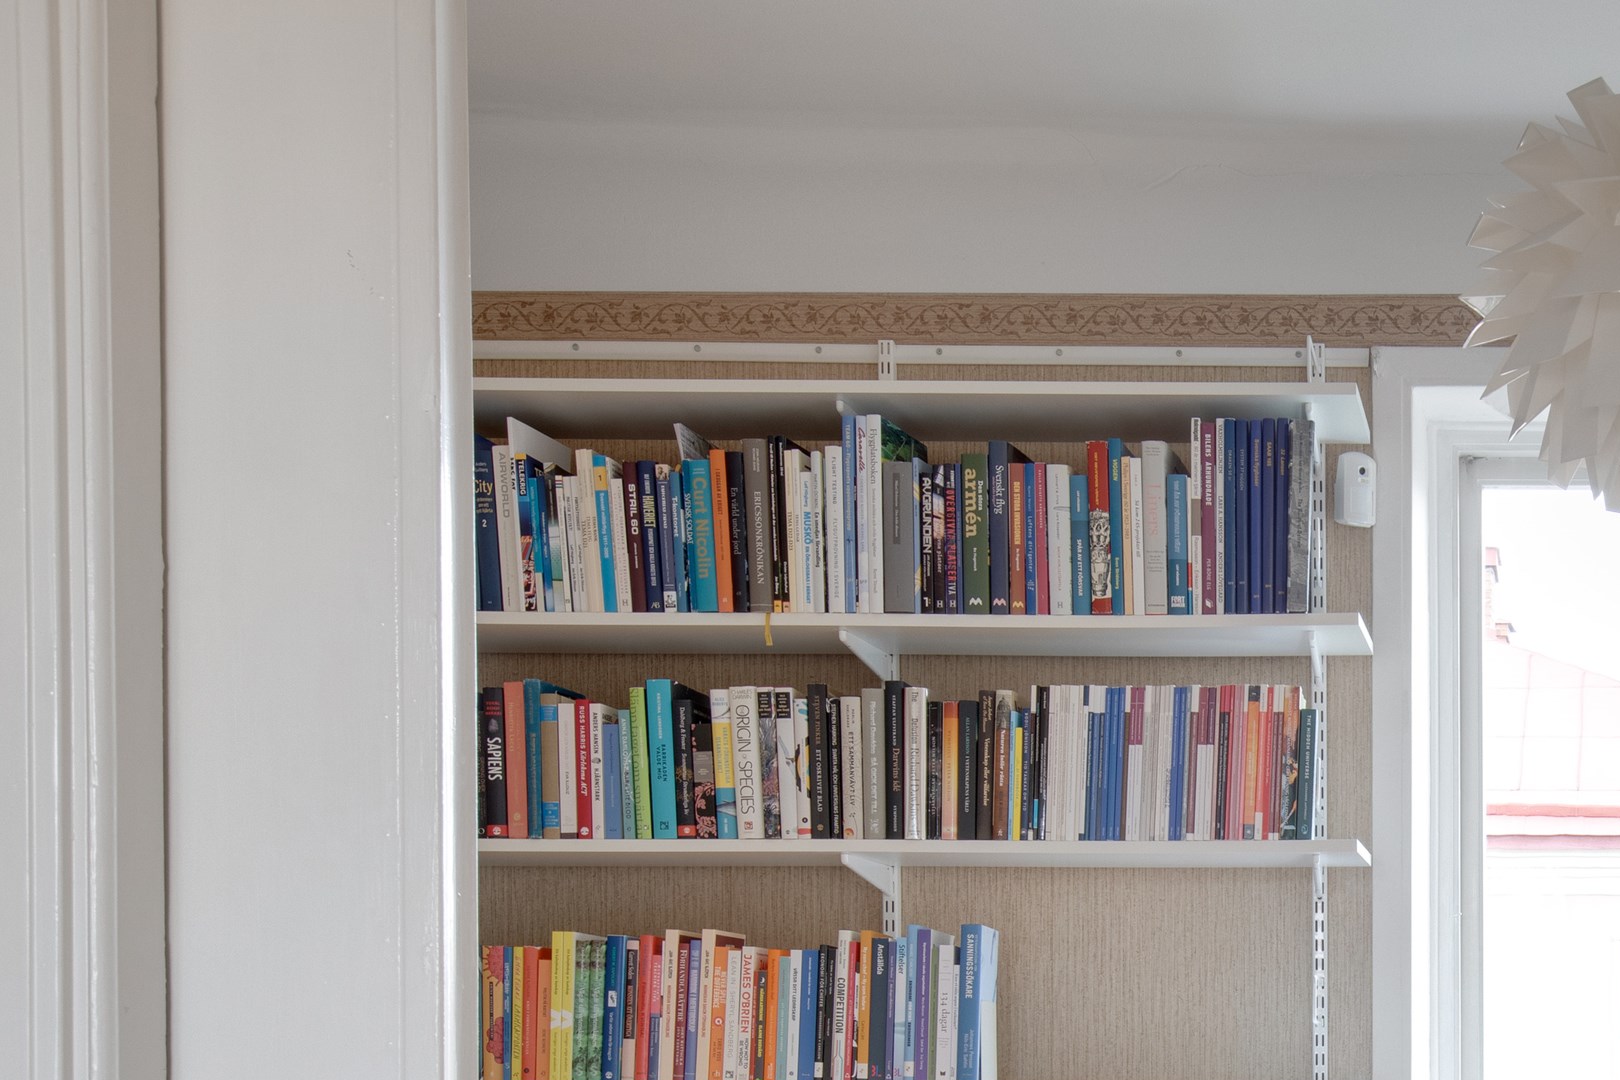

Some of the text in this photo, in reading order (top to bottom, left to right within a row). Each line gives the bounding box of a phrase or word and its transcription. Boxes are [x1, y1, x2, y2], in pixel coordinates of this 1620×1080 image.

[518, 461, 526, 495] TELEKRIG
[869, 428, 878, 484] Flygplatsboken
[499, 452, 510, 518] AIRWORLD
[629, 484, 639, 535] STRIL 60
[965, 468, 981, 538] armén
[994, 465, 1005, 514] Svenskt flyg
[642, 496, 656, 528] HAVERIET
[693, 477, 711, 578] Curt Nicolin
[730, 487, 741, 555] En värld under jord
[803, 512, 813, 544] MUSKÖ
[922, 478, 931, 553] AVGRUNDEN
[754, 492, 766, 584] ERICSSONKRÖNIKAN
[487, 737, 502, 780] SAPIENS
[736, 705, 755, 814] ORIGIN SPECIES
[982, 738, 990, 765] Vetenskap
[743, 955, 751, 988] JAMES
[876, 944, 884, 975] Anställda
[965, 934, 974, 998] SANNINGSSÖKARE
[677, 994, 685, 1022] BÄTTRE
[835, 978, 845, 1033] COMPETITION
[939, 1009, 950, 1032] dagar
